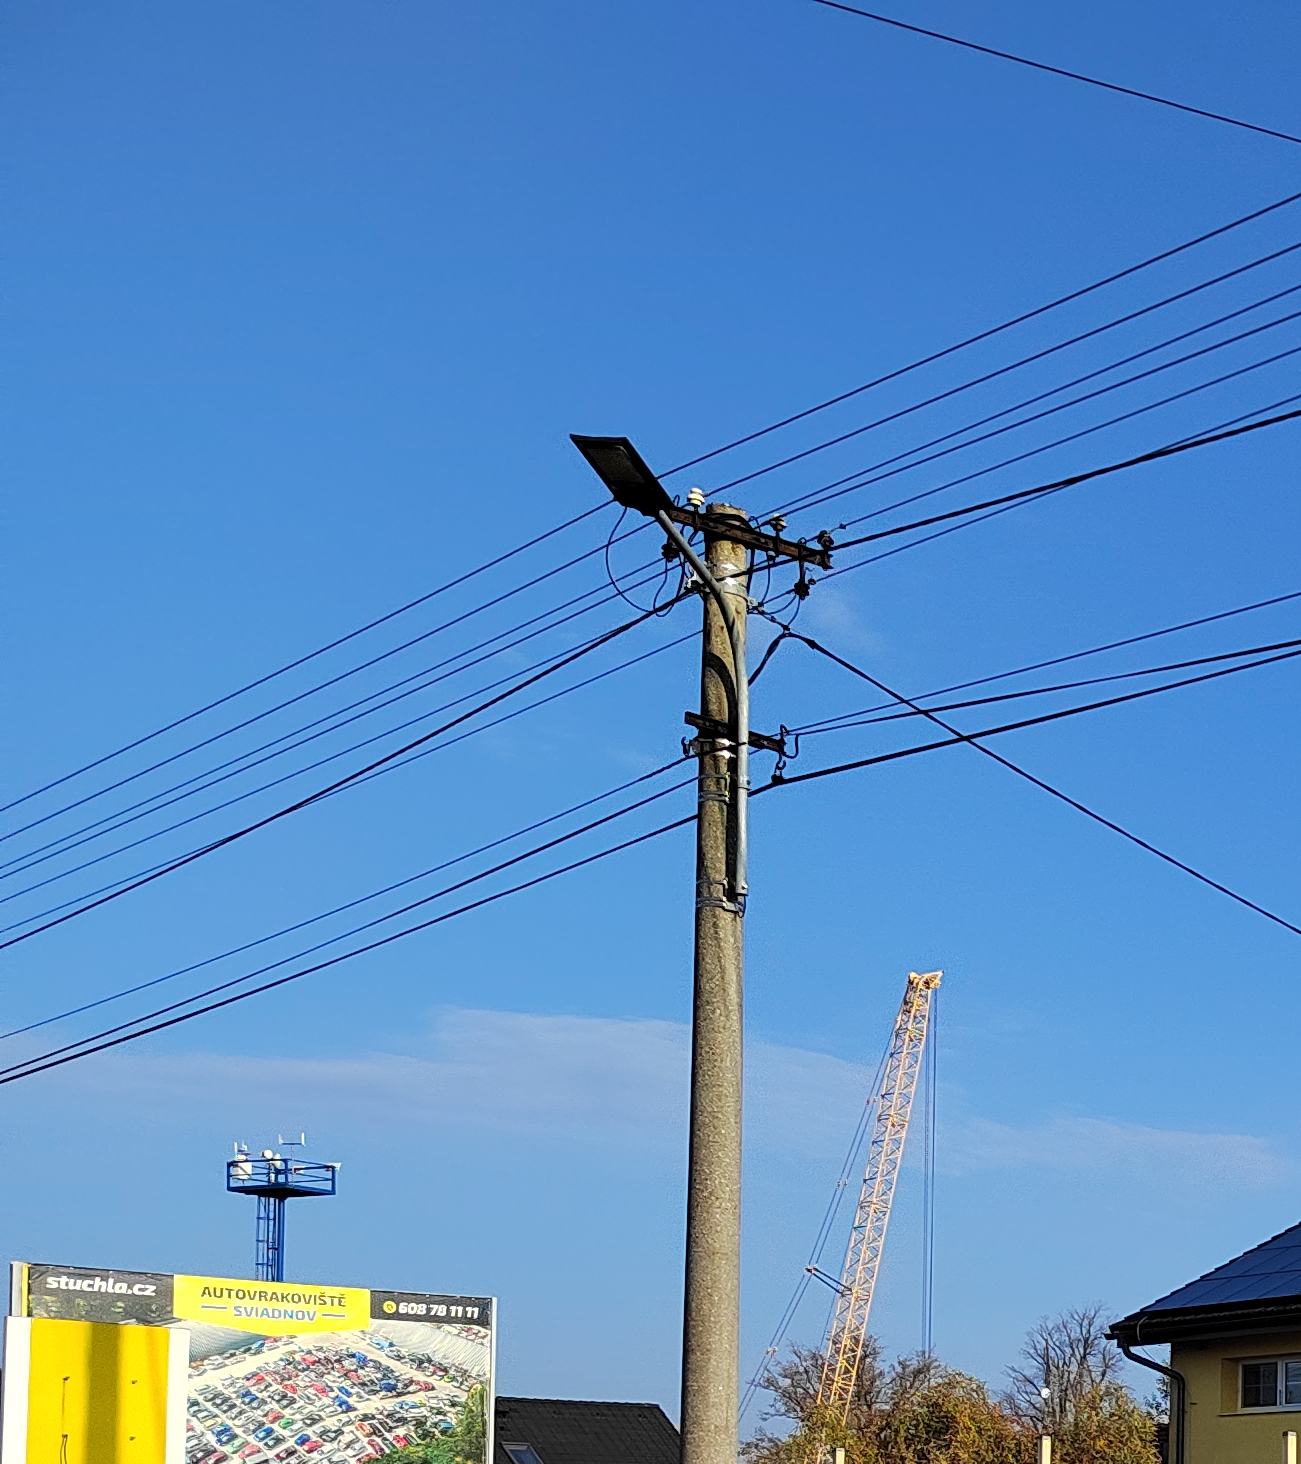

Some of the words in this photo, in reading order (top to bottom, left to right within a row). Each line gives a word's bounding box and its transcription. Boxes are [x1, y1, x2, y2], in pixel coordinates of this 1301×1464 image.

[46, 1275, 156, 1297] stuchla.cz
[201, 1286, 346, 1308] AUTOVRAKOVIŠTĚ
[233, 1305, 317, 1321] SVIADNOV
[398, 1303, 427, 1316] 608
[430, 1304, 446, 1317] 78
[449, 1305, 463, 1318] 11
[465, 1307, 479, 1319] 11
